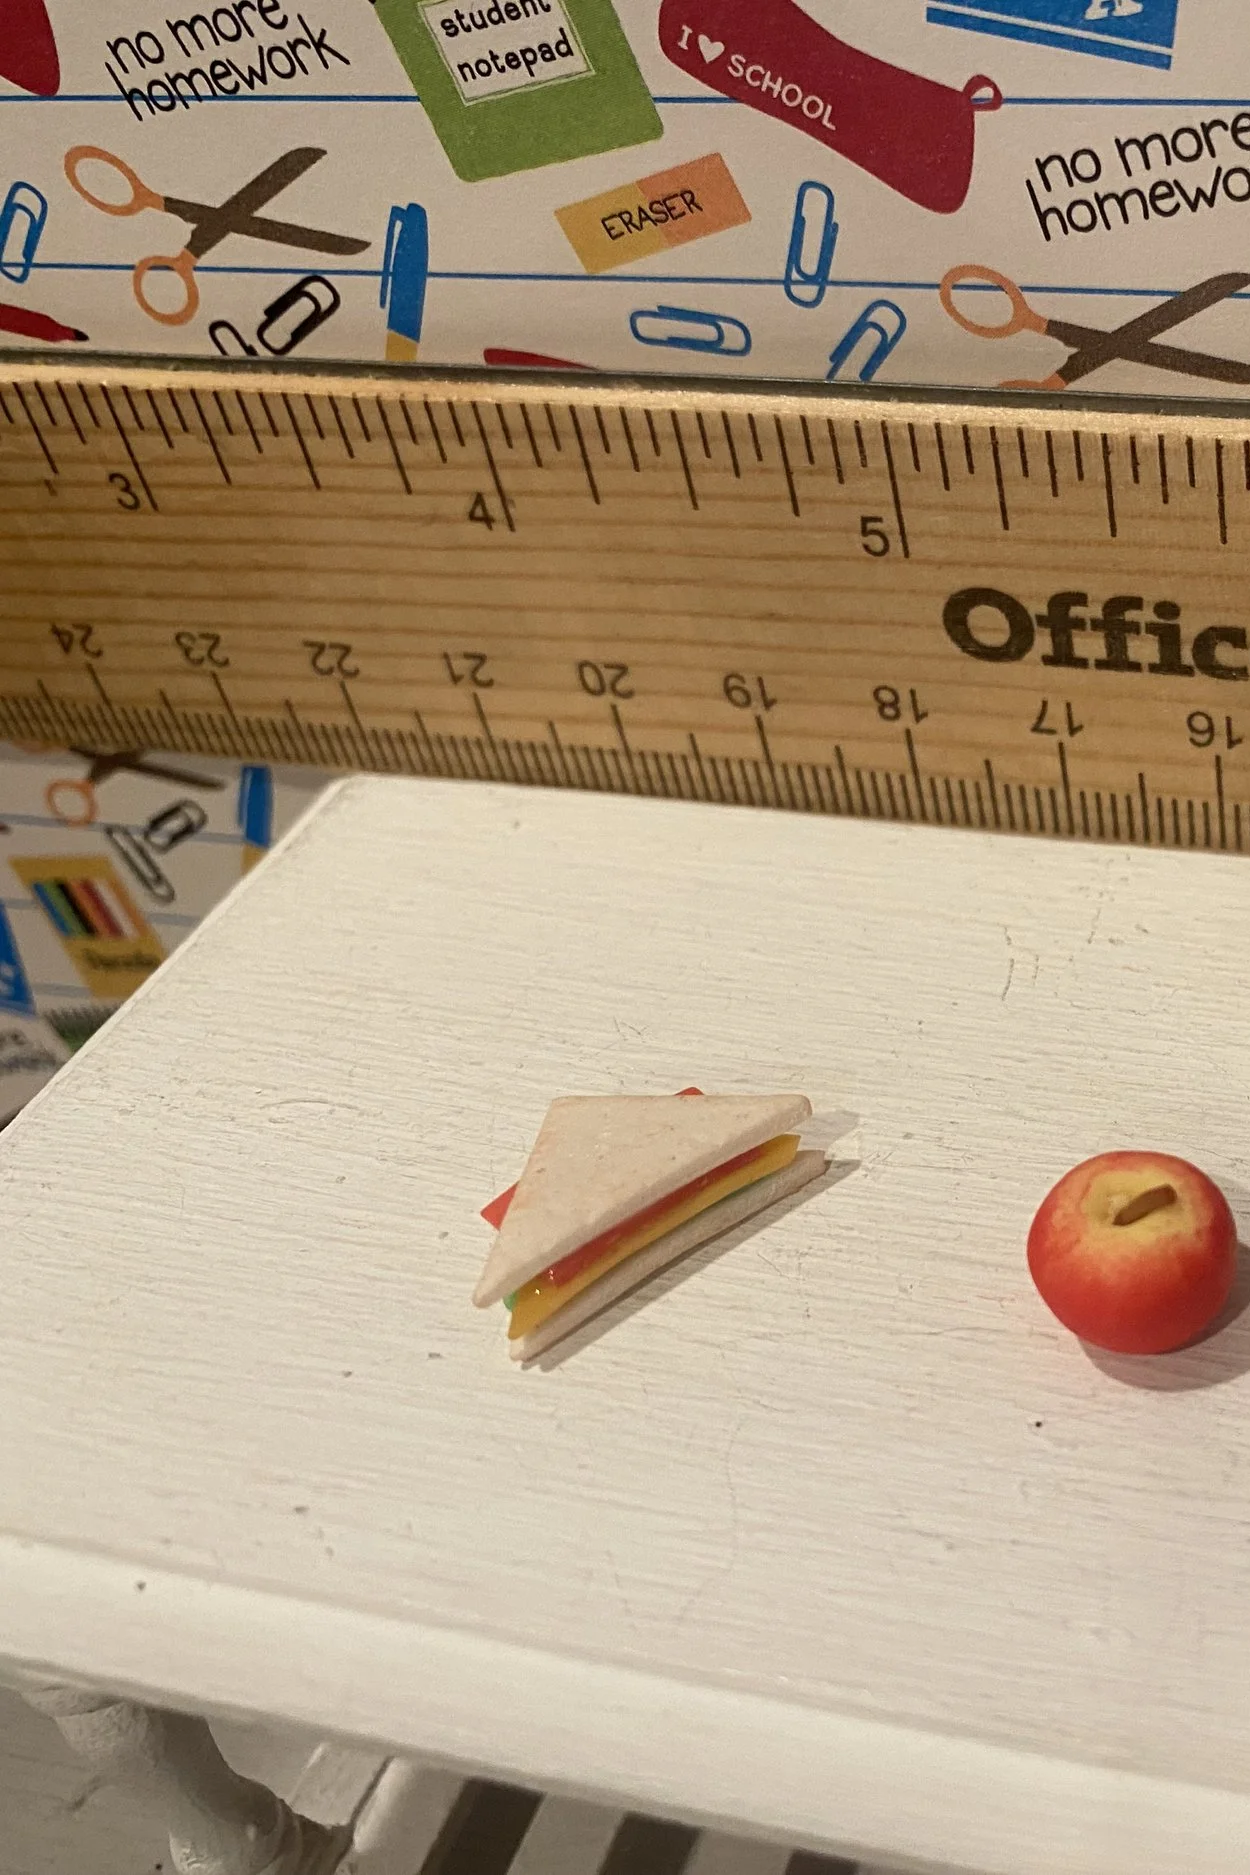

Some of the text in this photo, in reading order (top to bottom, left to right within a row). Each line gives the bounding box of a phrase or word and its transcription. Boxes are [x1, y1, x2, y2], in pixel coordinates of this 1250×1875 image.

[105, 13, 350, 121] homework
[107, 0, 289, 73] no more
[457, 27, 574, 82] notepad
[676, 25, 837, 131] I SCHOOL
[1034, 150, 1101, 191] no
[602, 189, 703, 241] ERASER
[108, 473, 141, 510] 3
[468, 493, 494, 531] 4
[860, 516, 890, 557] 5
[51, 622, 103, 658] 24
[174, 631, 229, 667] 23
[302, 640, 360, 678] 22
[442, 652, 495, 688] 21
[578, 660, 636, 699] 20
[723, 673, 778, 711] 19
[873, 685, 929, 725] 18
[1031, 699, 1084, 738] 17
[1186, 711, 1244, 750] 16
